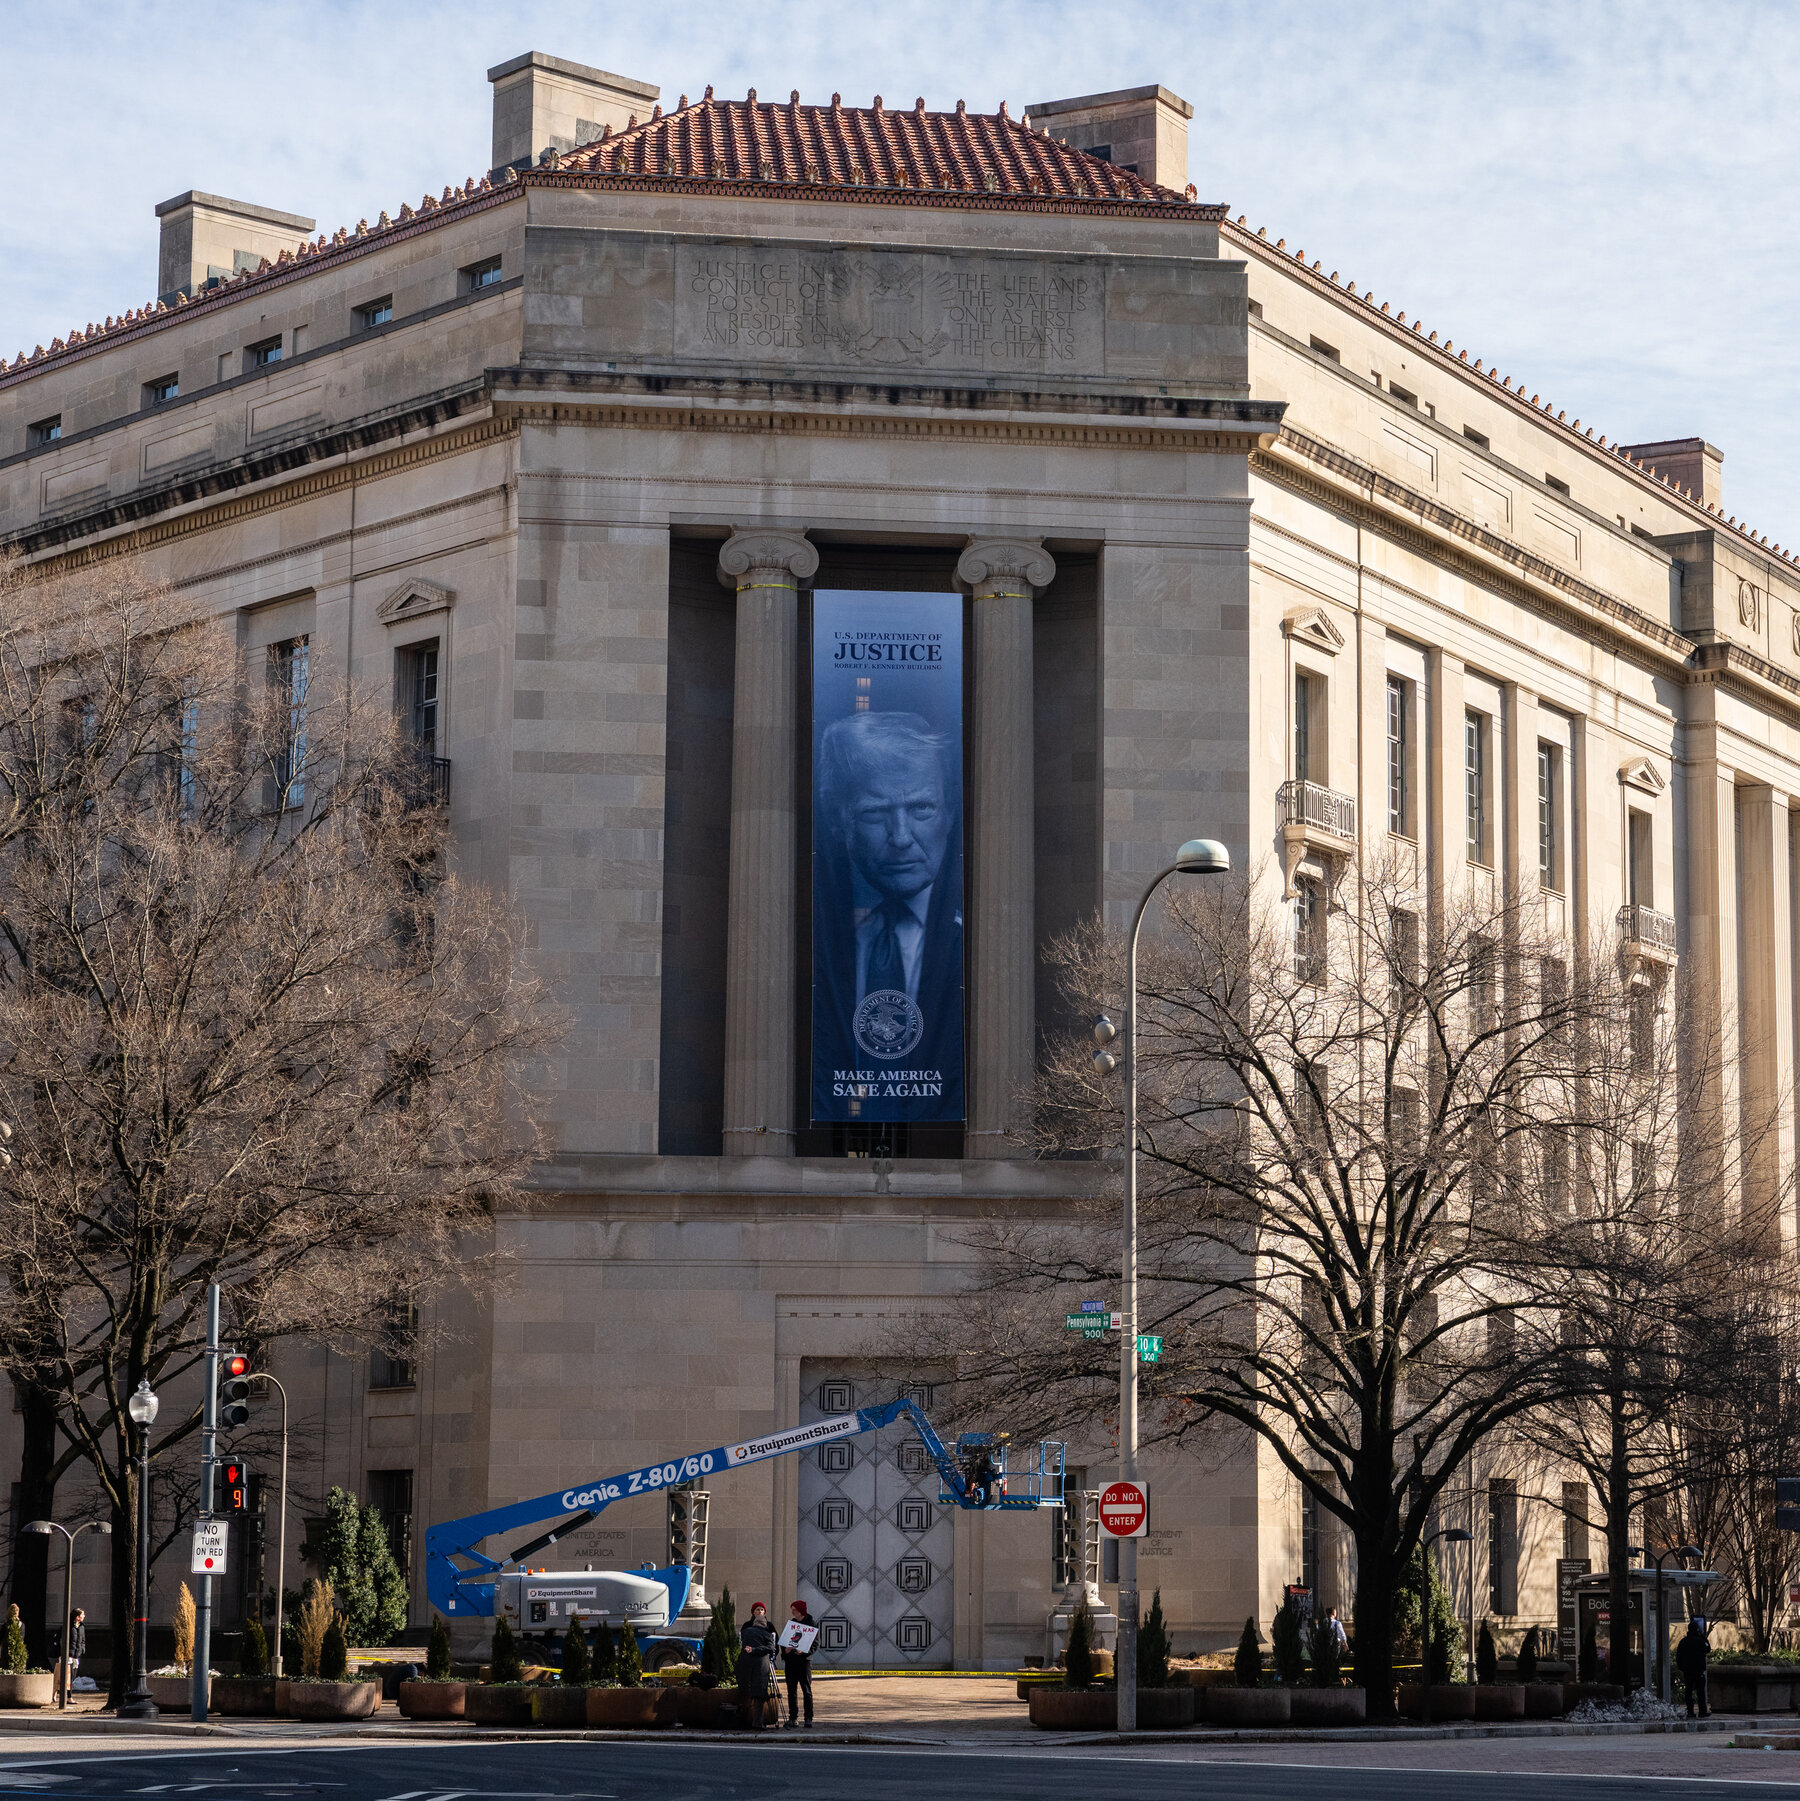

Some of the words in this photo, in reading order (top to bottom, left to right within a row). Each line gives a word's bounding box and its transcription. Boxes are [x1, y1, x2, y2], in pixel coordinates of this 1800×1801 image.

[691, 261, 790, 280] JUSTICE
[803, 265, 825, 282] IN
[953, 273, 991, 290] THE
[1003, 275, 1039, 293] LIFE
[1046, 278, 1089, 295] AND
[691, 278, 792, 297] CONDUCT
[800, 283, 825, 299] OF
[958, 290, 993, 307] THE
[1003, 293, 1058, 310] STATE
[1070, 296, 1087, 312] IS
[708, 295, 825, 316] POSSIBLE
[950, 306, 996, 324] ONLY
[1001, 309, 1023, 325] AS
[1031, 310, 1075, 327] FIRST
[706, 312, 721, 328] IT
[728, 313, 803, 331] RESIDES
[811, 316, 829, 333] IN
[956, 323, 993, 340] THE
[1004, 325, 1075, 344] HEARTS
[702, 328, 739, 345] AND
[746, 330, 805, 348] SOULS
[812, 334, 832, 349] OF
[951, 339, 984, 357] THE
[990, 341, 1076, 360] CITIZENS.
[834, 632, 854, 640] U.S.
[856, 632, 926, 641] DEPARTMENT
[834, 643, 942, 662] JUSTICE
[859, 996, 891, 1033] DEPARTMENT
[833, 1071, 875, 1081] MAKE
[877, 1070, 943, 1081] AMERICA
[833, 1083, 880, 1097] SAFE
[882, 1083, 943, 1097] AGAIN
[1066, 1315, 1102, 1329] Pennsylvania
[1085, 1330, 1101, 1338] 900
[1144, 1353, 1155, 1361] 300
[749, 1421, 850, 1455] EquipmentShare
[562, 1483, 621, 1510] Genie
[628, 1454, 714, 1494] Z-80/60
[233, 1490, 242, 1508] 9
[1105, 1493, 1118, 1502] DO
[1122, 1493, 1140, 1502] NOT
[1108, 1517, 1136, 1526] ENTER
[203, 1525, 218, 1535] NO
[1149, 1531, 1183, 1539] RTMENT
[565, 1532, 595, 1540] UNITED
[597, 1532, 626, 1540] STATES
[201, 1537, 220, 1546] TURN
[196, 1547, 206, 1556] ON
[208, 1548, 224, 1557] RED
[574, 1549, 615, 1557] AMERICA
[1140, 1547, 1173, 1556] JUSTICE
[538, 1590, 594, 1598] EquipmentShare
[618, 1601, 649, 1611] Genie
